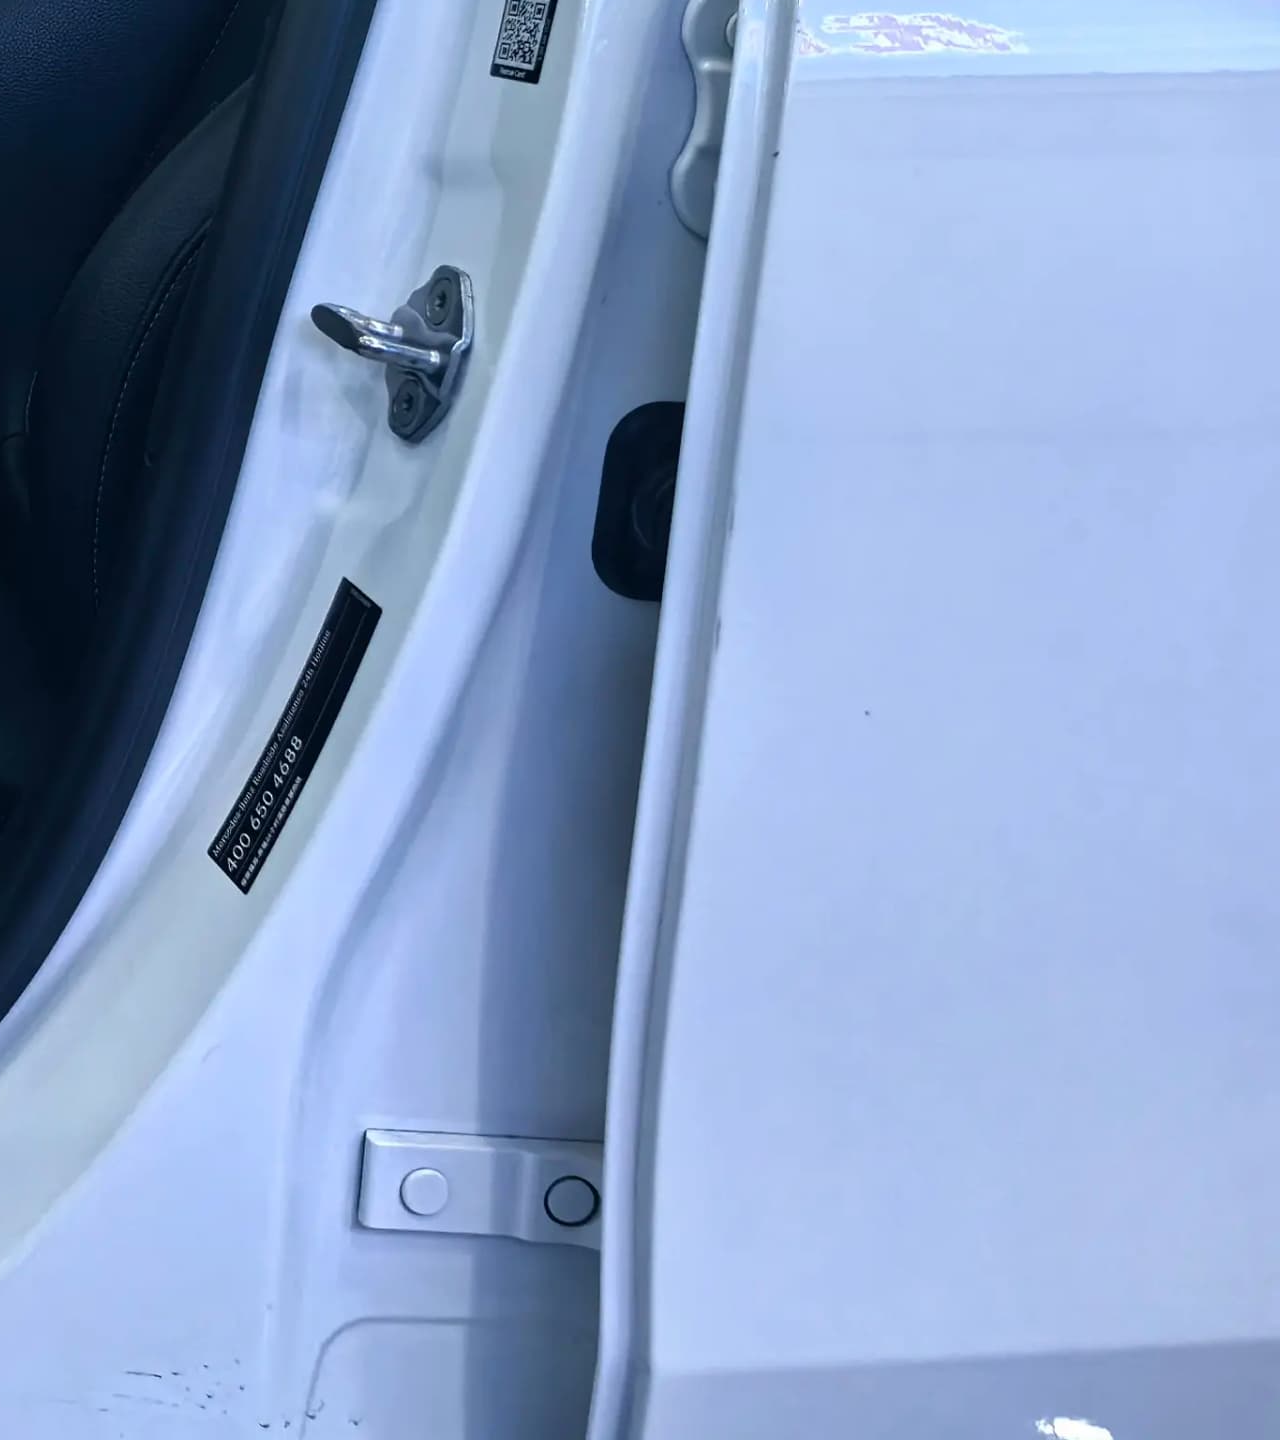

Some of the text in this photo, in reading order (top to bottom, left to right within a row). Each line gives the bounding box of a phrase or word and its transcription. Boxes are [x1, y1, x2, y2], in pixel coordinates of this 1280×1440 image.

[227, 735, 303, 873] 400 650 4688
